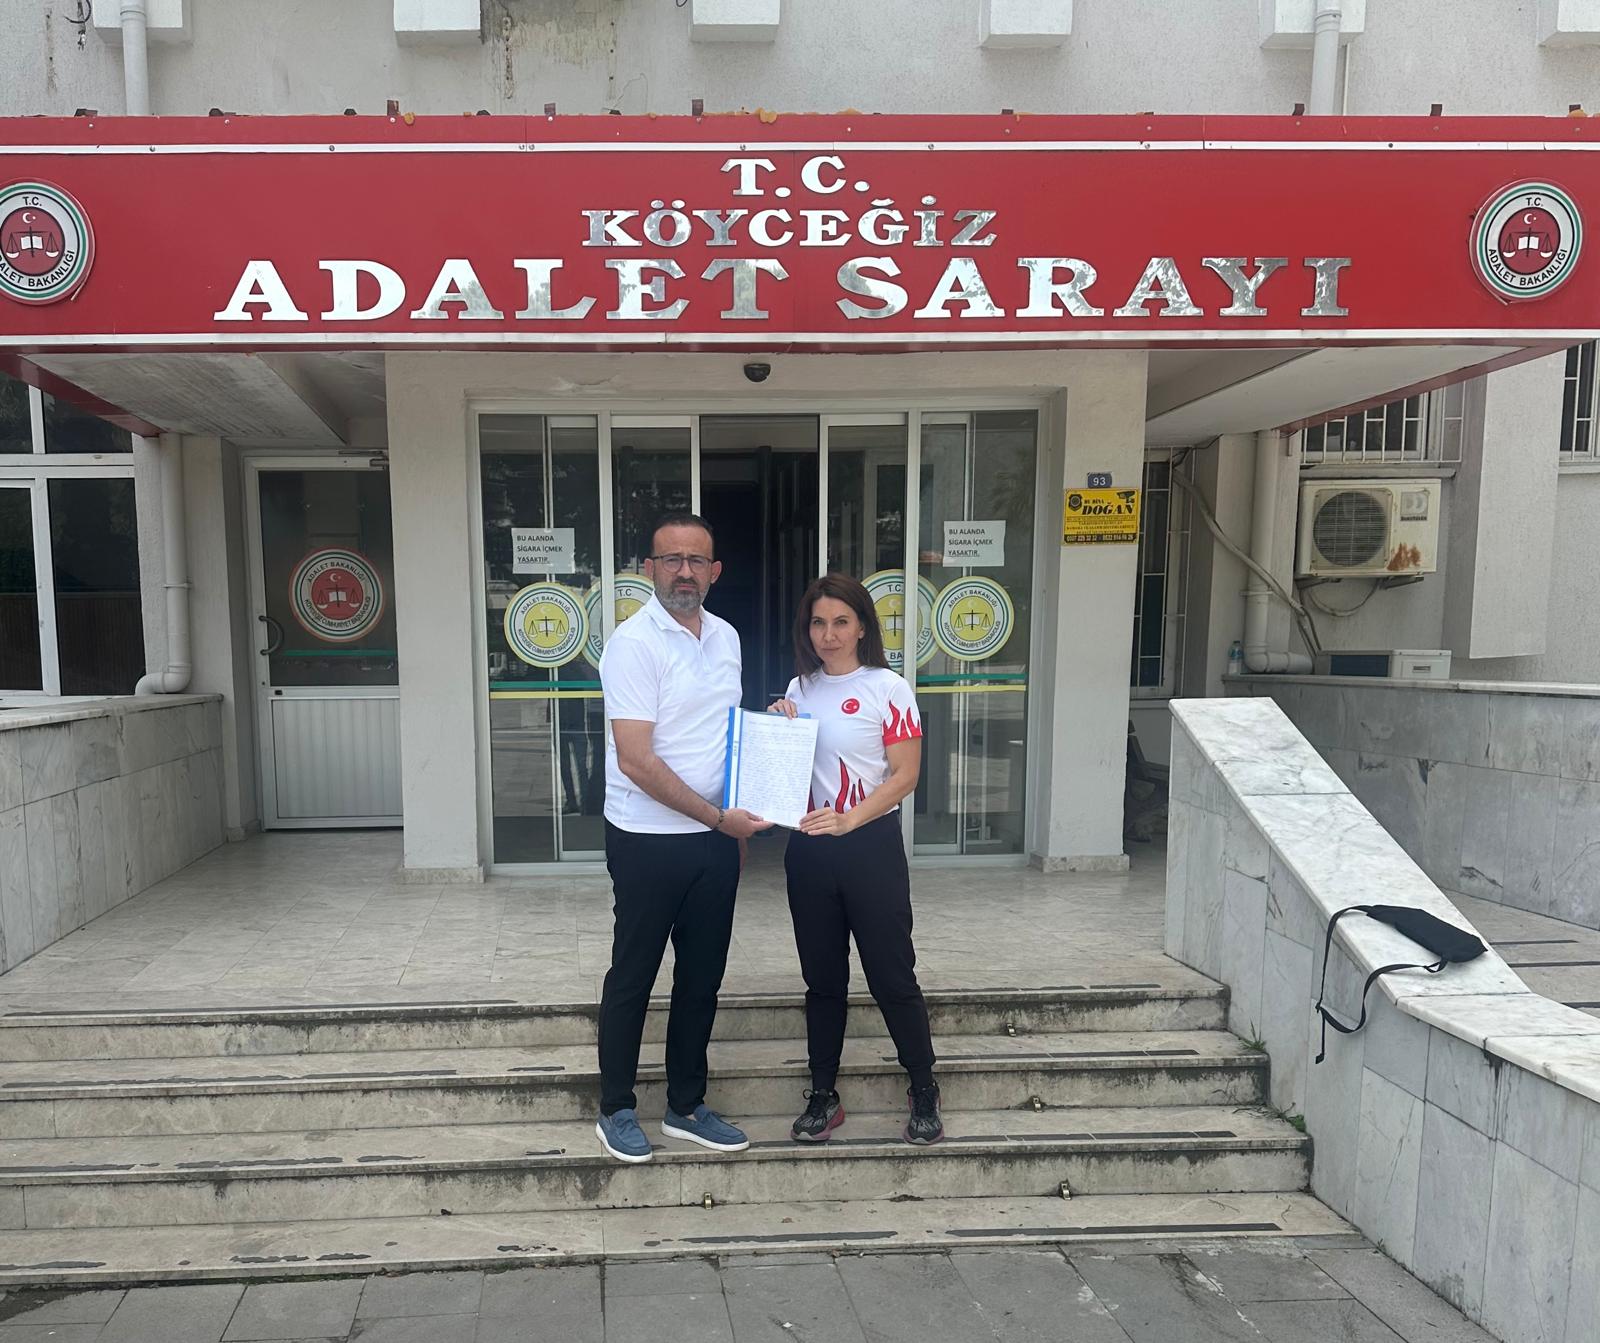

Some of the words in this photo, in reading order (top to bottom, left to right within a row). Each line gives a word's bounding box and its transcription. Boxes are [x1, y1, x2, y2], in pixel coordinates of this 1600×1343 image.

[720, 155, 871, 198] T.C.
[23, 197, 42, 206] T.C.
[1526, 197, 1544, 206] T.C.
[581, 195, 998, 250] KÖYCEĞİZ
[1489, 249, 1516, 283] ADALET
[212, 256, 789, 325] ADALET
[836, 255, 1353, 322] SARAYI
[1093, 477, 1106, 486] 93
[1082, 502, 1135, 515] DOĞAN
[973, 538, 993, 546] İÇMEK
[542, 545, 563, 553] İÇMEK
